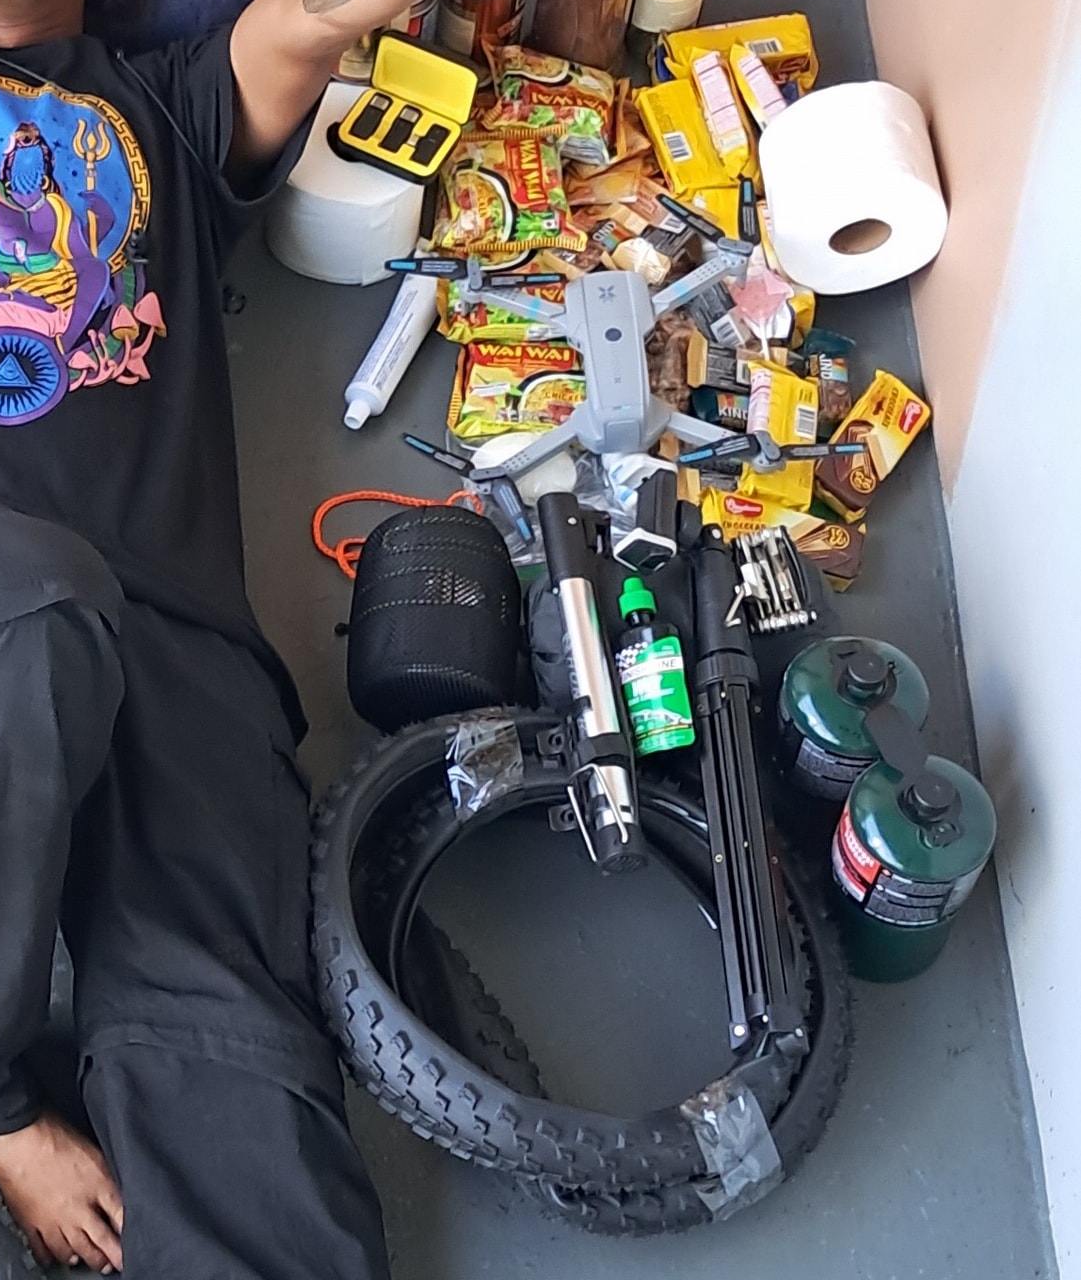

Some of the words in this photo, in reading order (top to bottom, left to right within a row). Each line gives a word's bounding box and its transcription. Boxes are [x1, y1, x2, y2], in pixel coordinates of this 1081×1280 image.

[532, 91, 575, 106] WAI
[521, 139, 539, 170] WAI
[477, 343, 522, 357] WAI
[525, 346, 571, 361] WAI
